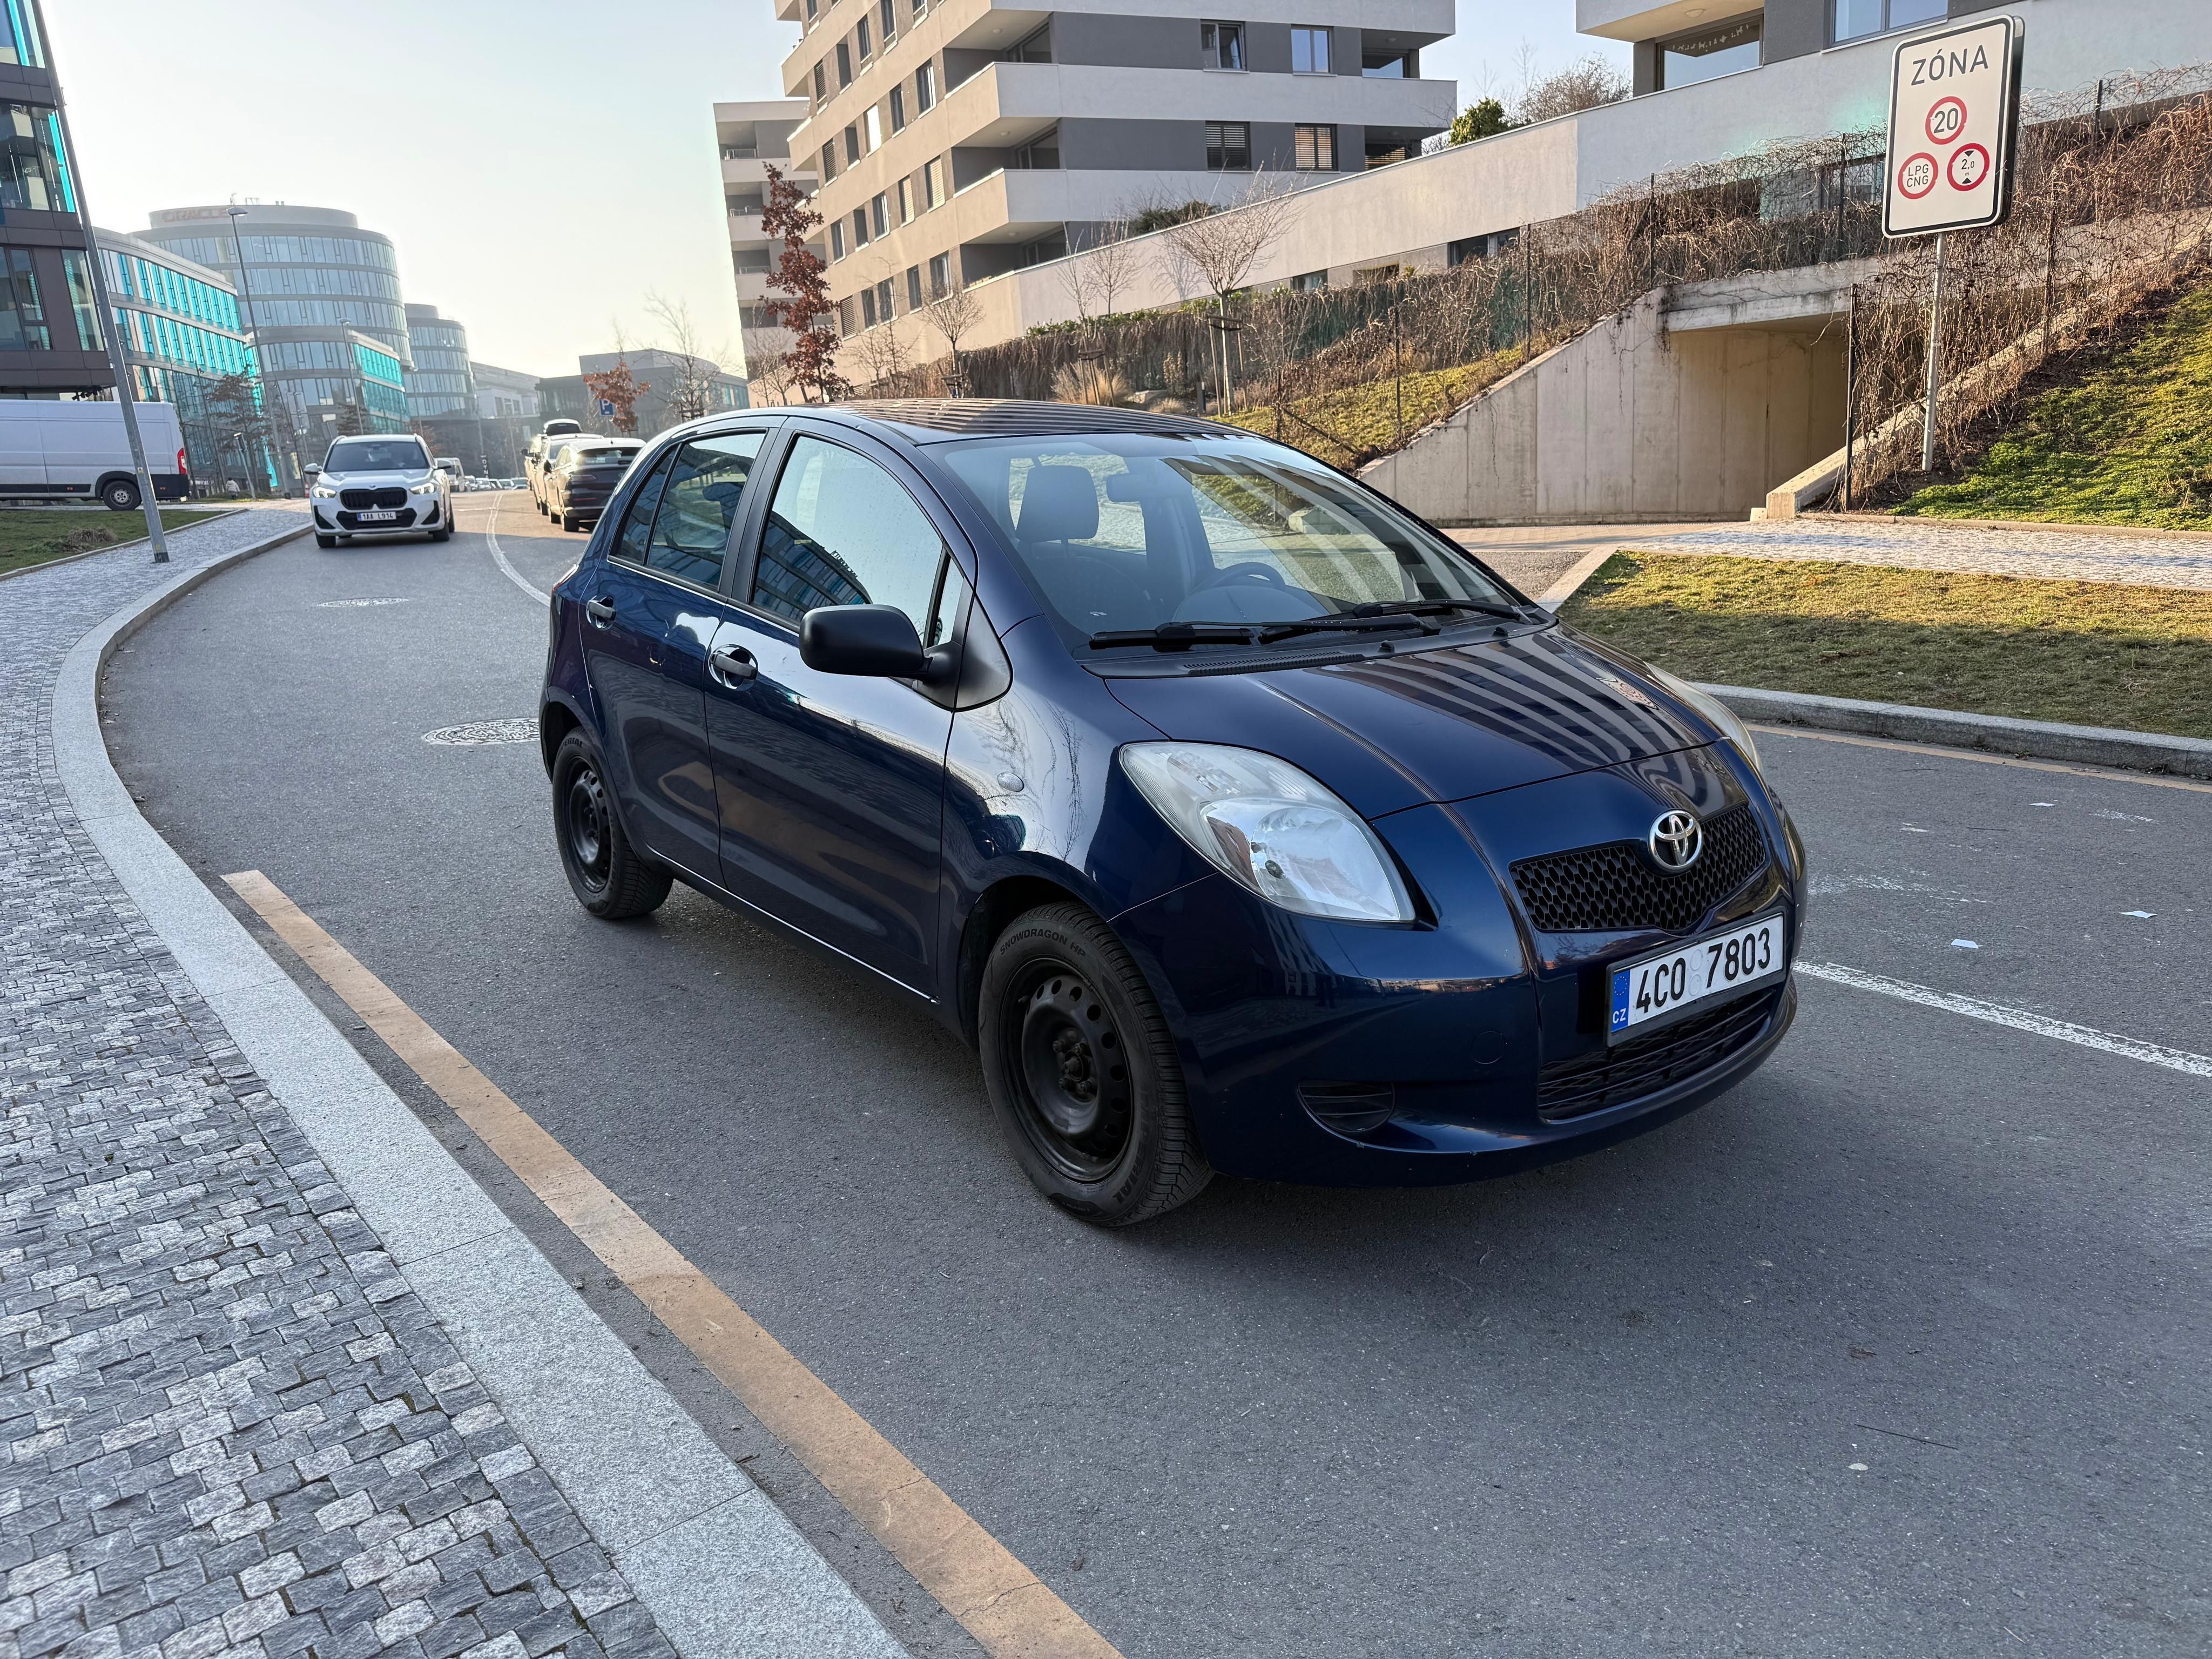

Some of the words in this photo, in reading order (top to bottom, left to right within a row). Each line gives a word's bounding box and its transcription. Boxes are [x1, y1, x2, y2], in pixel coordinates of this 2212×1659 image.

[1911, 44, 1989, 86] ZÓNA
[1933, 107, 1959, 134] 20
[1907, 164, 1929, 177] LPG
[1906, 176, 1929, 188] CNG
[601, 399, 610, 410] P
[999, 928, 1068, 955] SNOWDRAGON
[1069, 941, 1087, 957] HP
[1706, 927, 1771, 989] 7803
[1612, 1008, 1626, 1024] CZ
